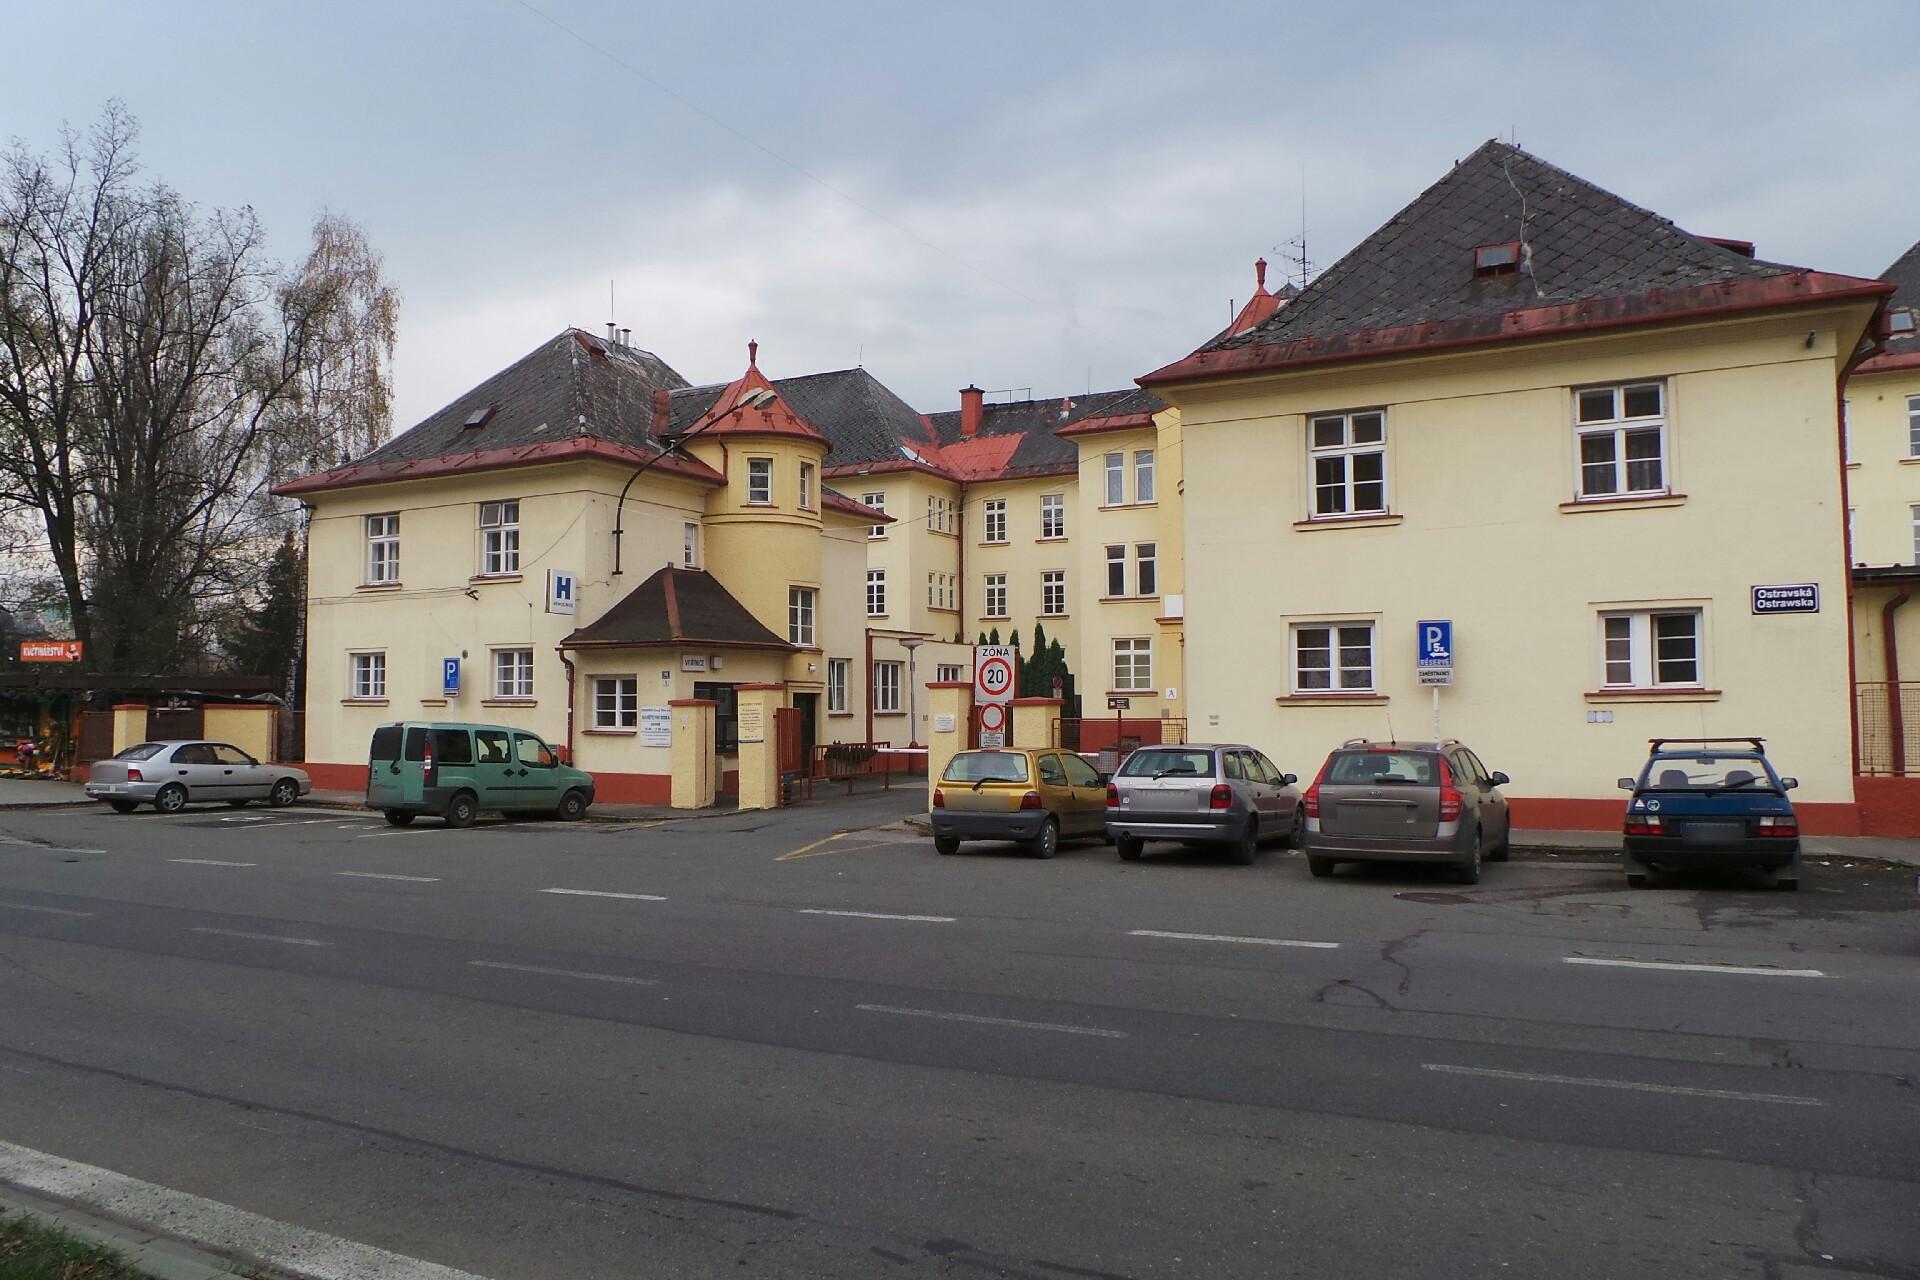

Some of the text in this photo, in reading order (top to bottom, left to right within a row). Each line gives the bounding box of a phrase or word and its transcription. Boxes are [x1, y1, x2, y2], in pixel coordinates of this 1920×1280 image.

[557, 576, 571, 600] H
[1757, 588, 1813, 599] Ostravská
[1757, 598, 1814, 608] Ostrawska
[1427, 626, 1442, 652] P
[982, 646, 1010, 657] ZÓNA
[1433, 643, 1445, 652] 5x
[447, 662, 456, 680] P
[987, 669, 1004, 684] 20
[1168, 689, 1175, 698] A
